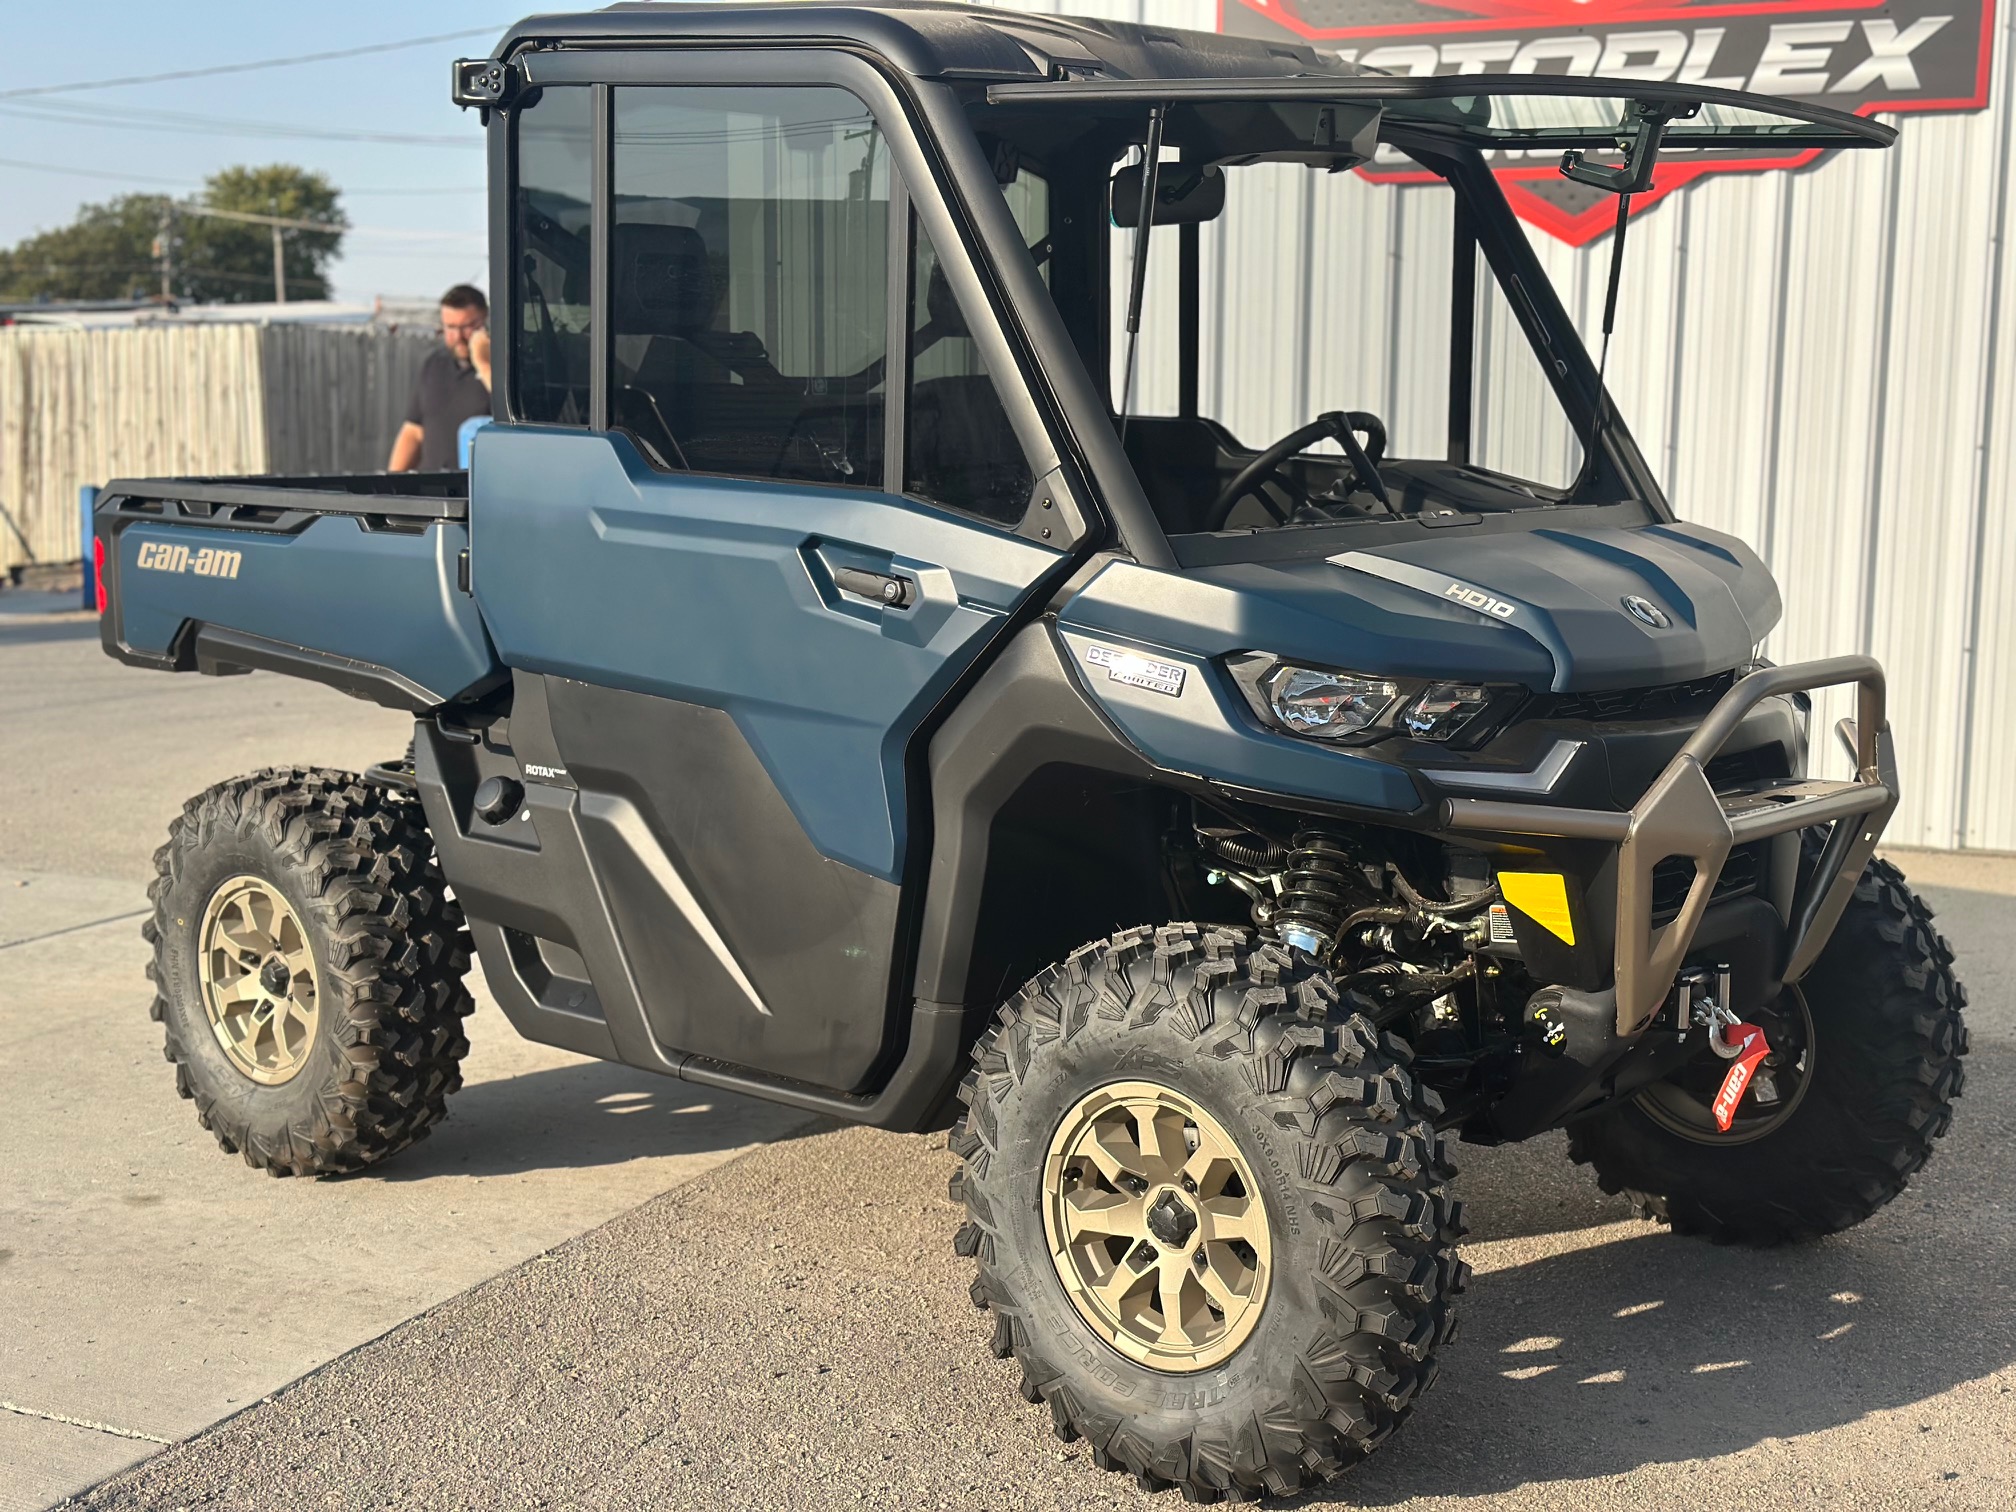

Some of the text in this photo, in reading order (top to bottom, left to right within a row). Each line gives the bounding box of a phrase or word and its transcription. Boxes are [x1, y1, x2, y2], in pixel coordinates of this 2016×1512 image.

[137, 542, 242, 580] can-am
[1444, 583, 1516, 618] HD10
[525, 764, 555, 778] ROTAX
[1285, 1205, 1301, 1236] NHS
